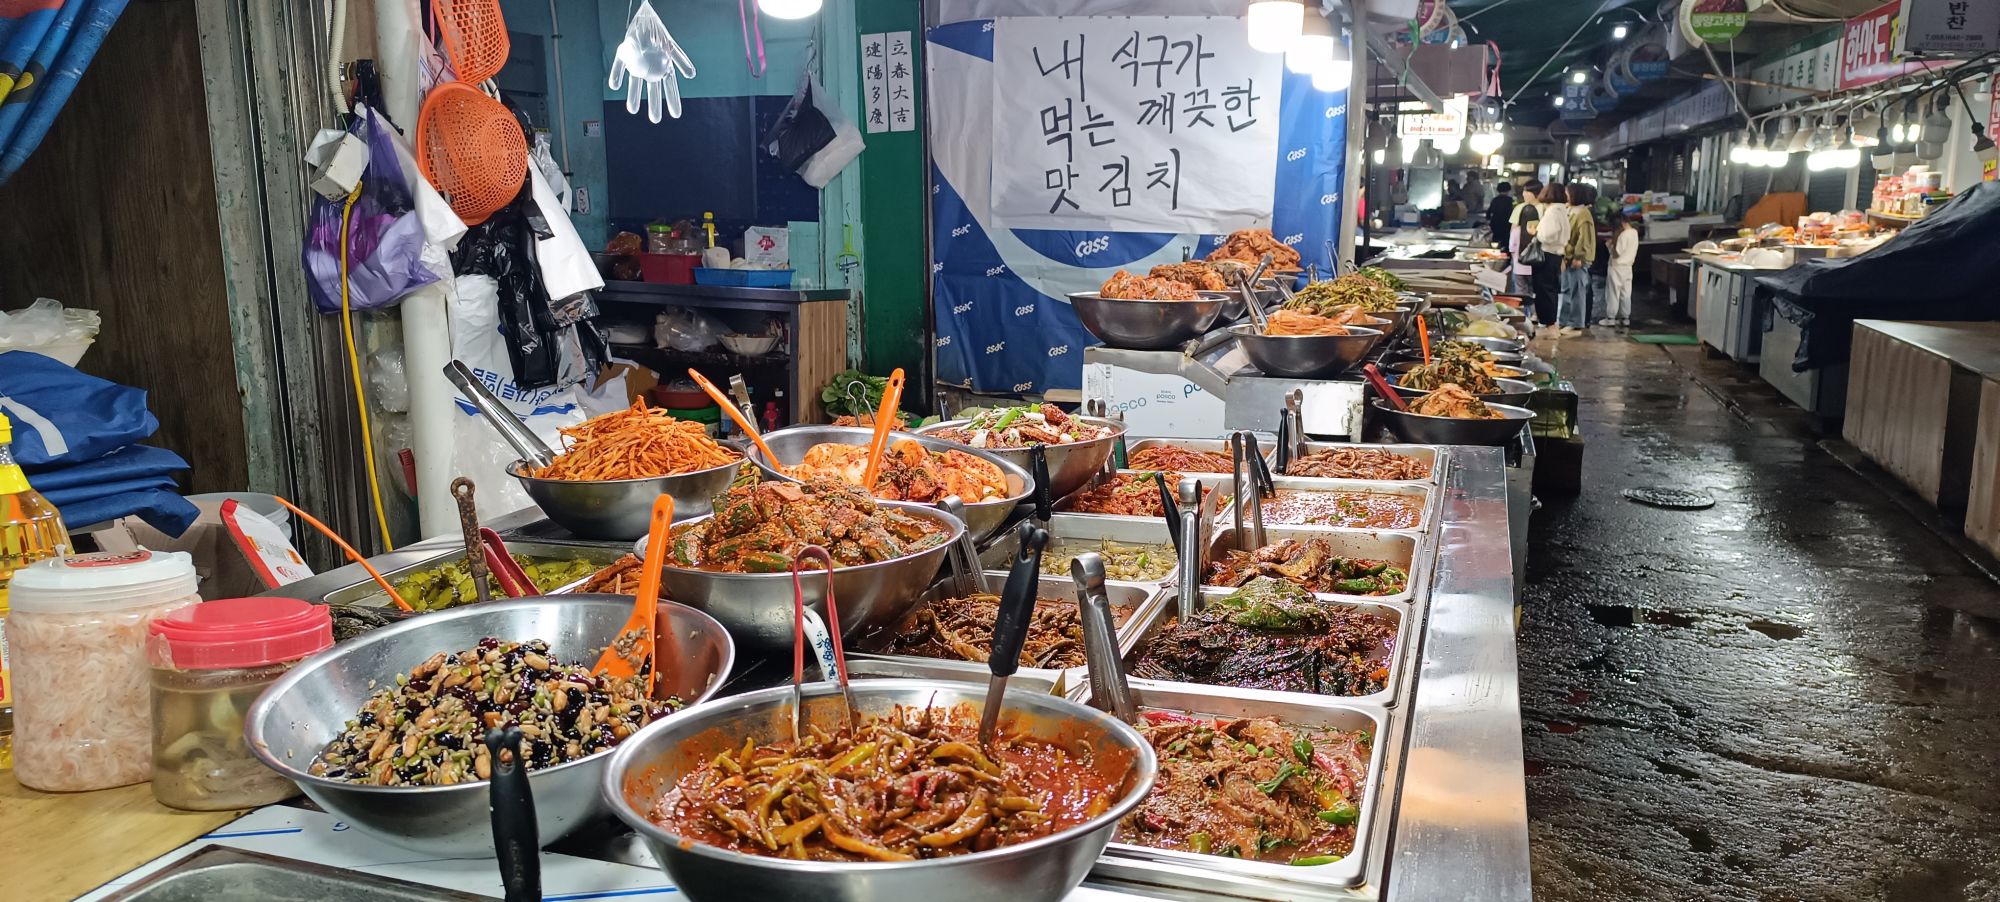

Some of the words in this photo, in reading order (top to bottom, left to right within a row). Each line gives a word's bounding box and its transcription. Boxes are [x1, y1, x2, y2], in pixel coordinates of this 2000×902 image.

[1947, 1, 1969, 30] 반찬
[1033, 33, 1085, 102] 내
[1112, 30, 1215, 88] 식구가
[865, 41, 884, 125] 建陽多慶
[891, 40, 910, 123] 立春大吉
[1040, 97, 1115, 163] 먹는
[1137, 78, 1261, 134] 깨끗한
[1325, 104, 1346, 118] Cass
[1287, 147, 1307, 162] Cass
[1075, 235, 1110, 258] Cass
[1014, 303, 1035, 317] Cass
[936, 335, 951, 347] ass
[1047, 344, 1069, 358] Cass
[1013, 381, 1033, 393] Cass
